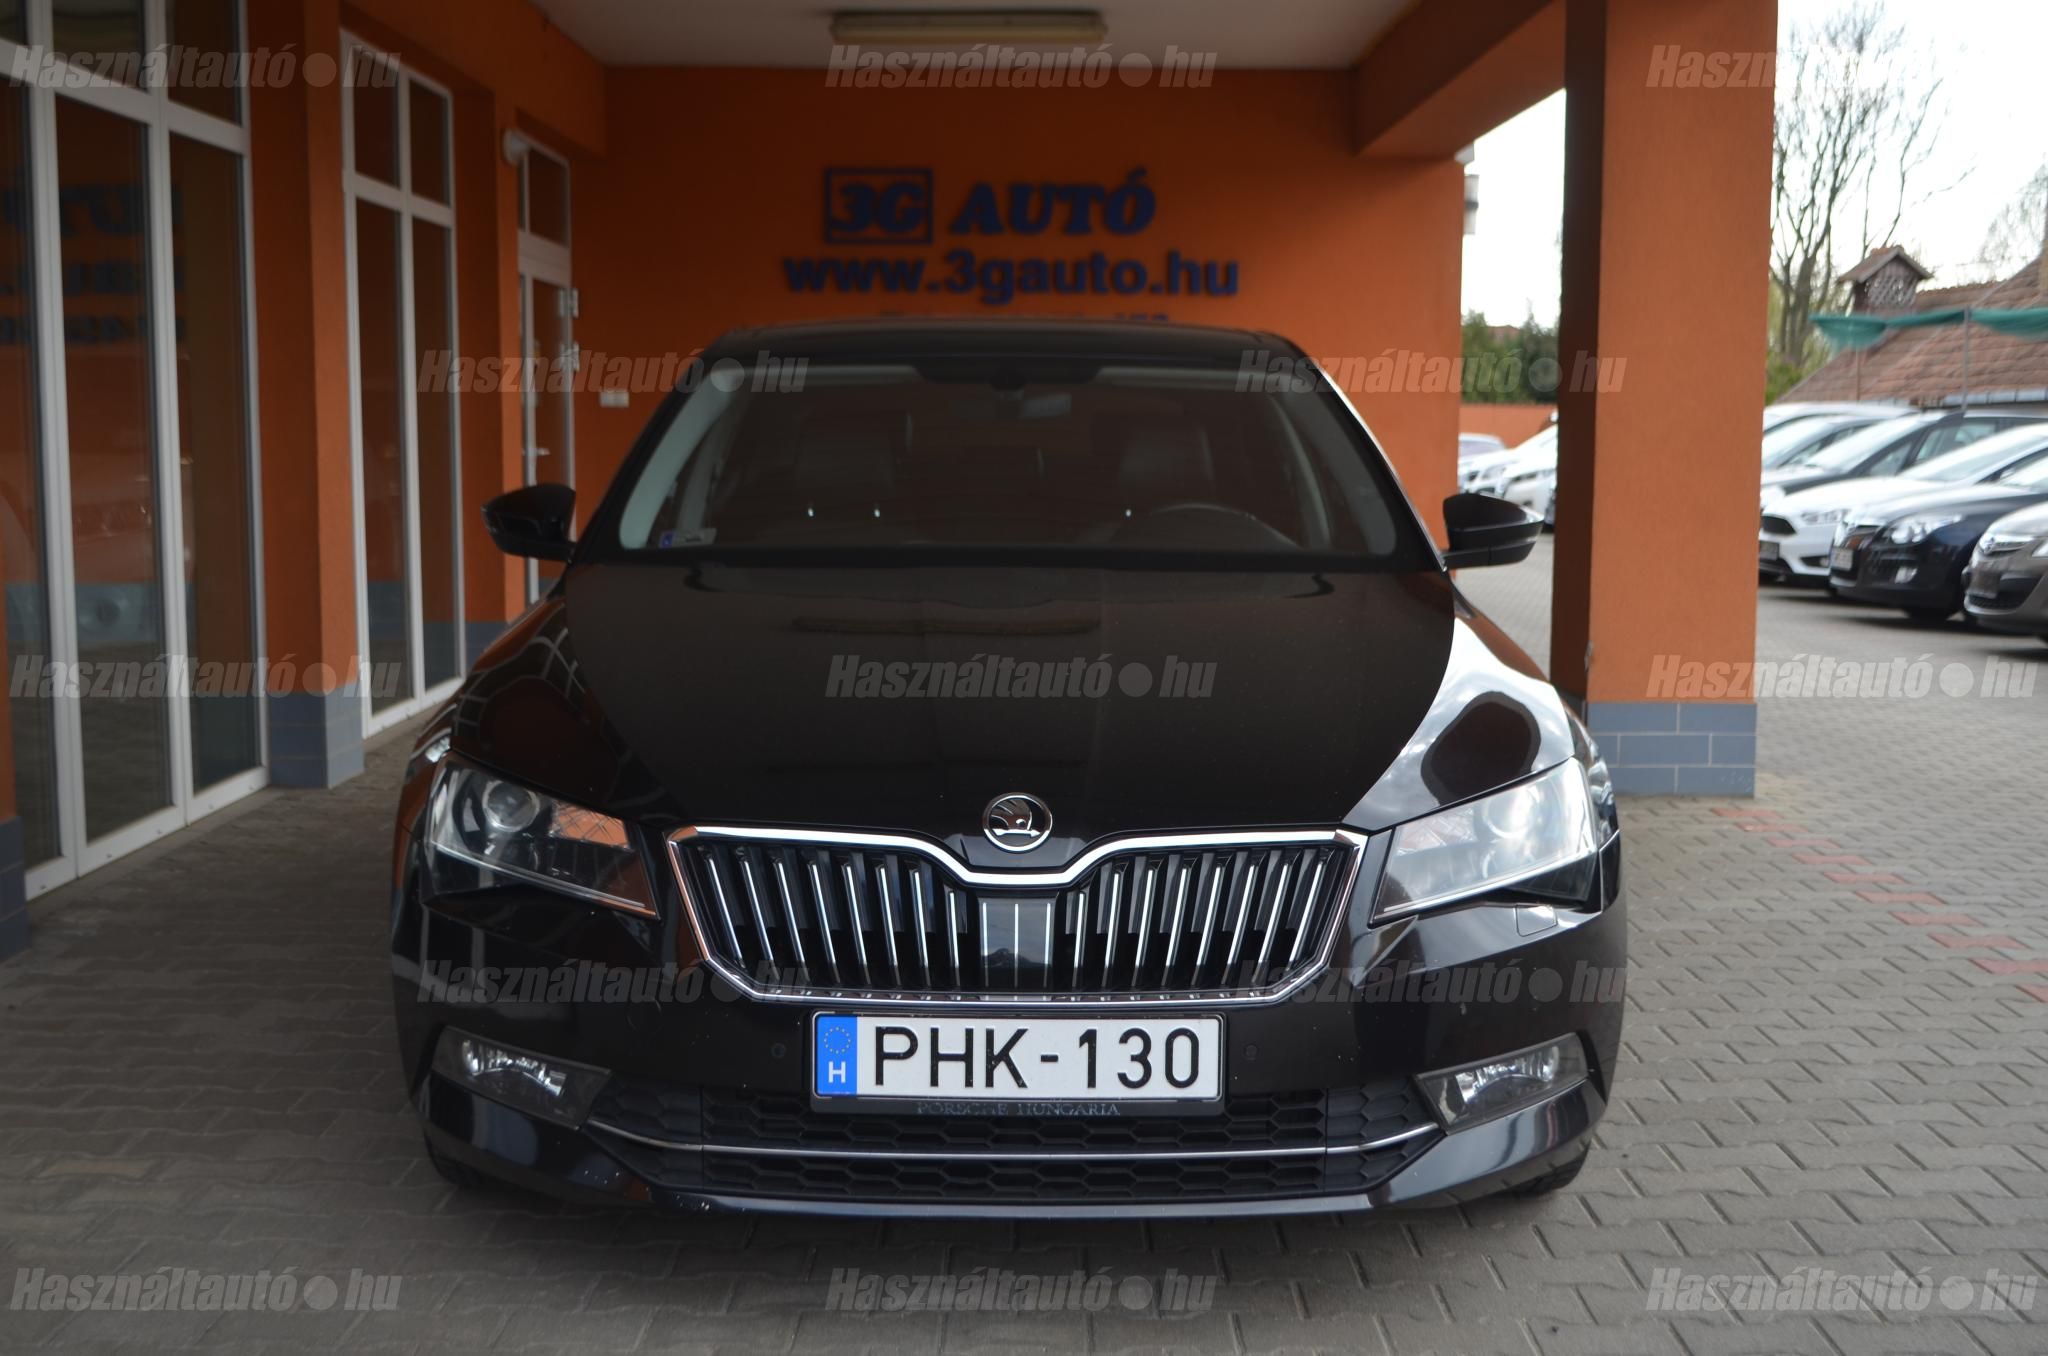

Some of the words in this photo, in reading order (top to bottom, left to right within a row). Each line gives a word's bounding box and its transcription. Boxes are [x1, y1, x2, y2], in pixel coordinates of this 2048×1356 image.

[829, 181, 927, 234] 3G
[948, 166, 1157, 236] AUTÓ
[782, 247, 1239, 306] www.3gauto.hu
[828, 1062, 847, 1084] H
[874, 1026, 1200, 1090] PHK-130
[917, 1101, 1008, 1116] PORSCHE
[1016, 1102, 1121, 1117] HUNGARIA
